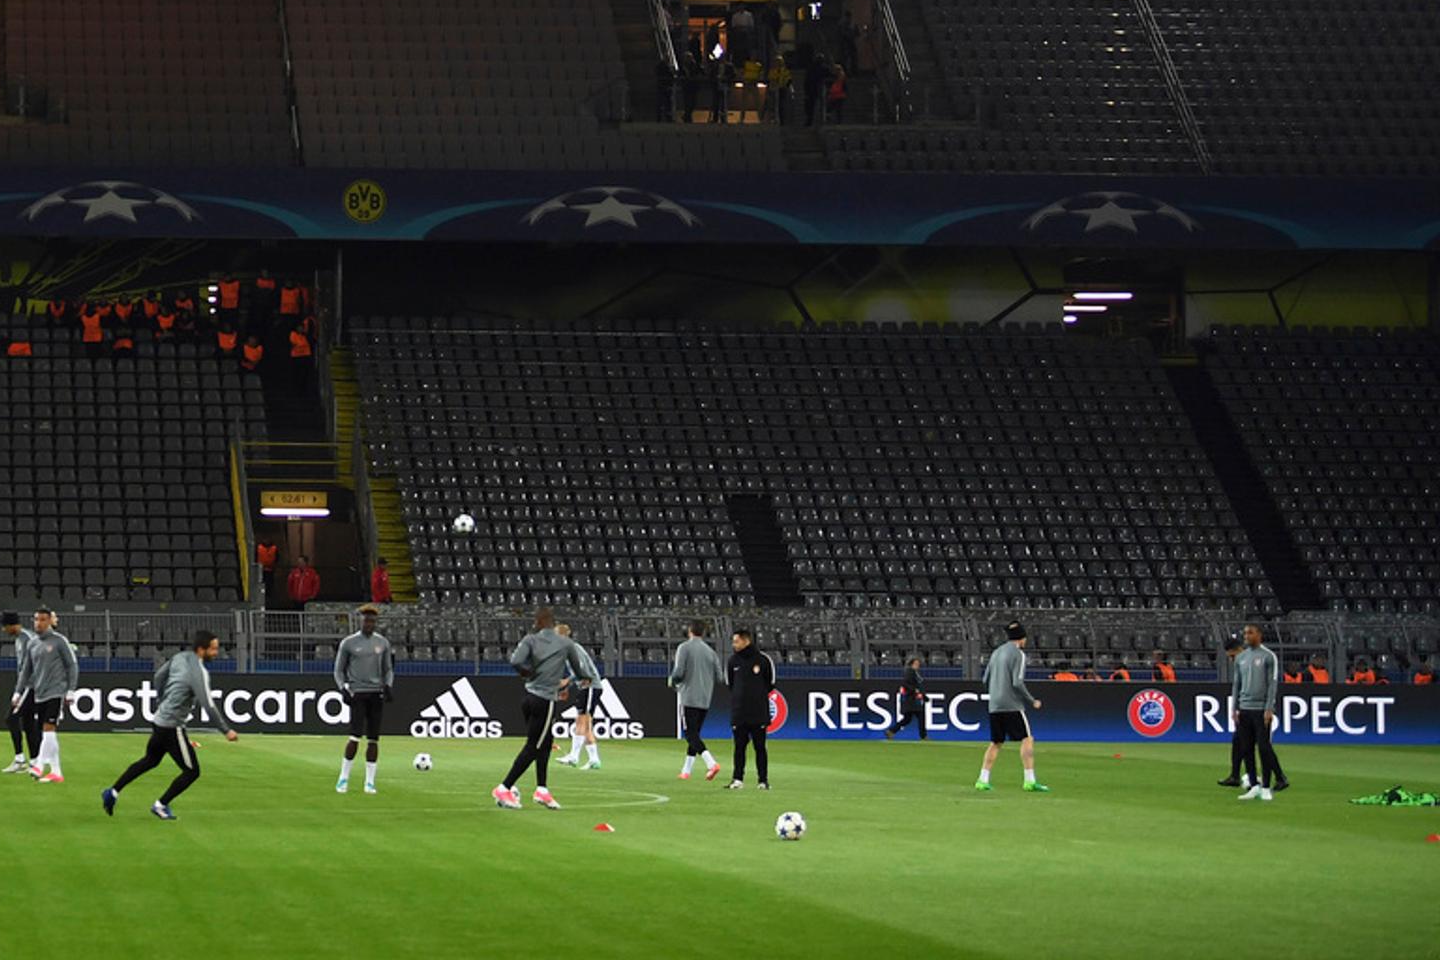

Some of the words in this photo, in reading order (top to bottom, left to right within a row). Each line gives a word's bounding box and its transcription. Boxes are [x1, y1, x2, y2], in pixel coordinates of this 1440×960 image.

[349, 185, 380, 209] BVB
[808, 692, 991, 731] RESEC
[1195, 695, 1394, 734] RPECT
[410, 715, 503, 739] adidas
[551, 716, 644, 739] adas
